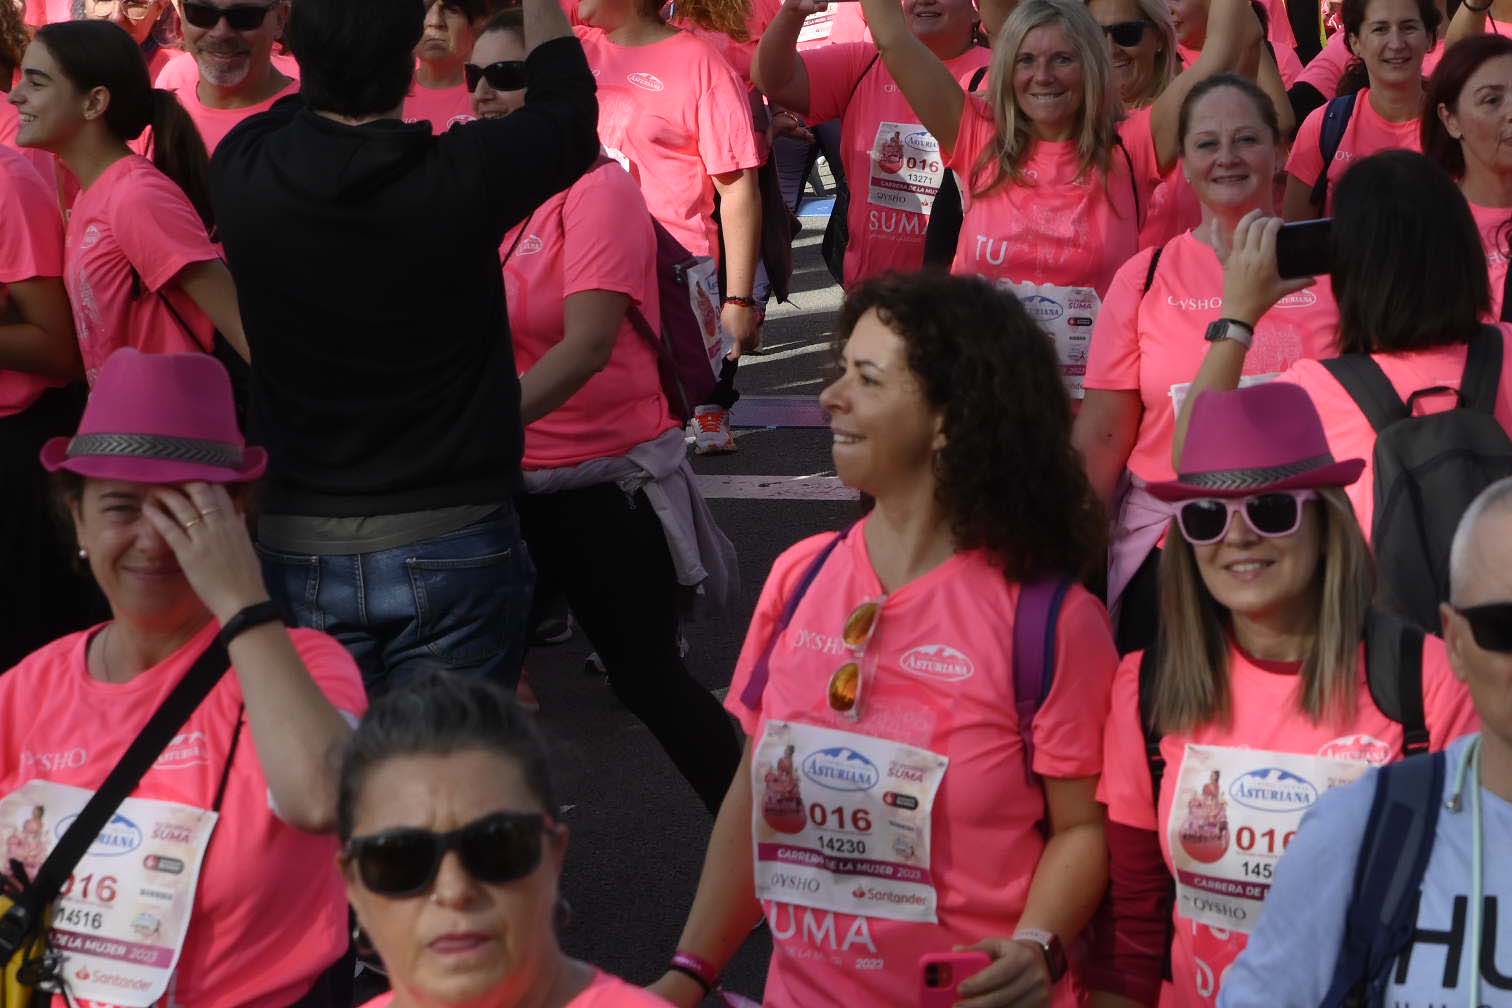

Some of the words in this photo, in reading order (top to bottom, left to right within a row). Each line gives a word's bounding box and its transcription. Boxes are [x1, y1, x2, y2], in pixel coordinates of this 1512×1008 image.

[907, 157, 939, 173] 016
[908, 174, 933, 185] 13271
[877, 192, 906, 204] OYSHO
[976, 235, 1007, 266] TU
[808, 759, 872, 786] ASTURIANA
[888, 768, 924, 783] SUMA
[1240, 782, 1310, 803] ASTURIANA
[809, 802, 872, 832] 016
[152, 829, 191, 843] SUMA
[817, 835, 867, 855] 14230
[856, 862, 894, 876] MUJER
[771, 872, 821, 893] OYSHO
[1194, 878, 1243, 895] CARRERA
[1246, 885, 1262, 897] DE
[868, 888, 927, 905] Santander
[1194, 897, 1247, 921] OYSHO
[84, 940, 127, 956] MUJER
[130, 947, 159, 962] 2023
[92, 971, 153, 991] Santander
